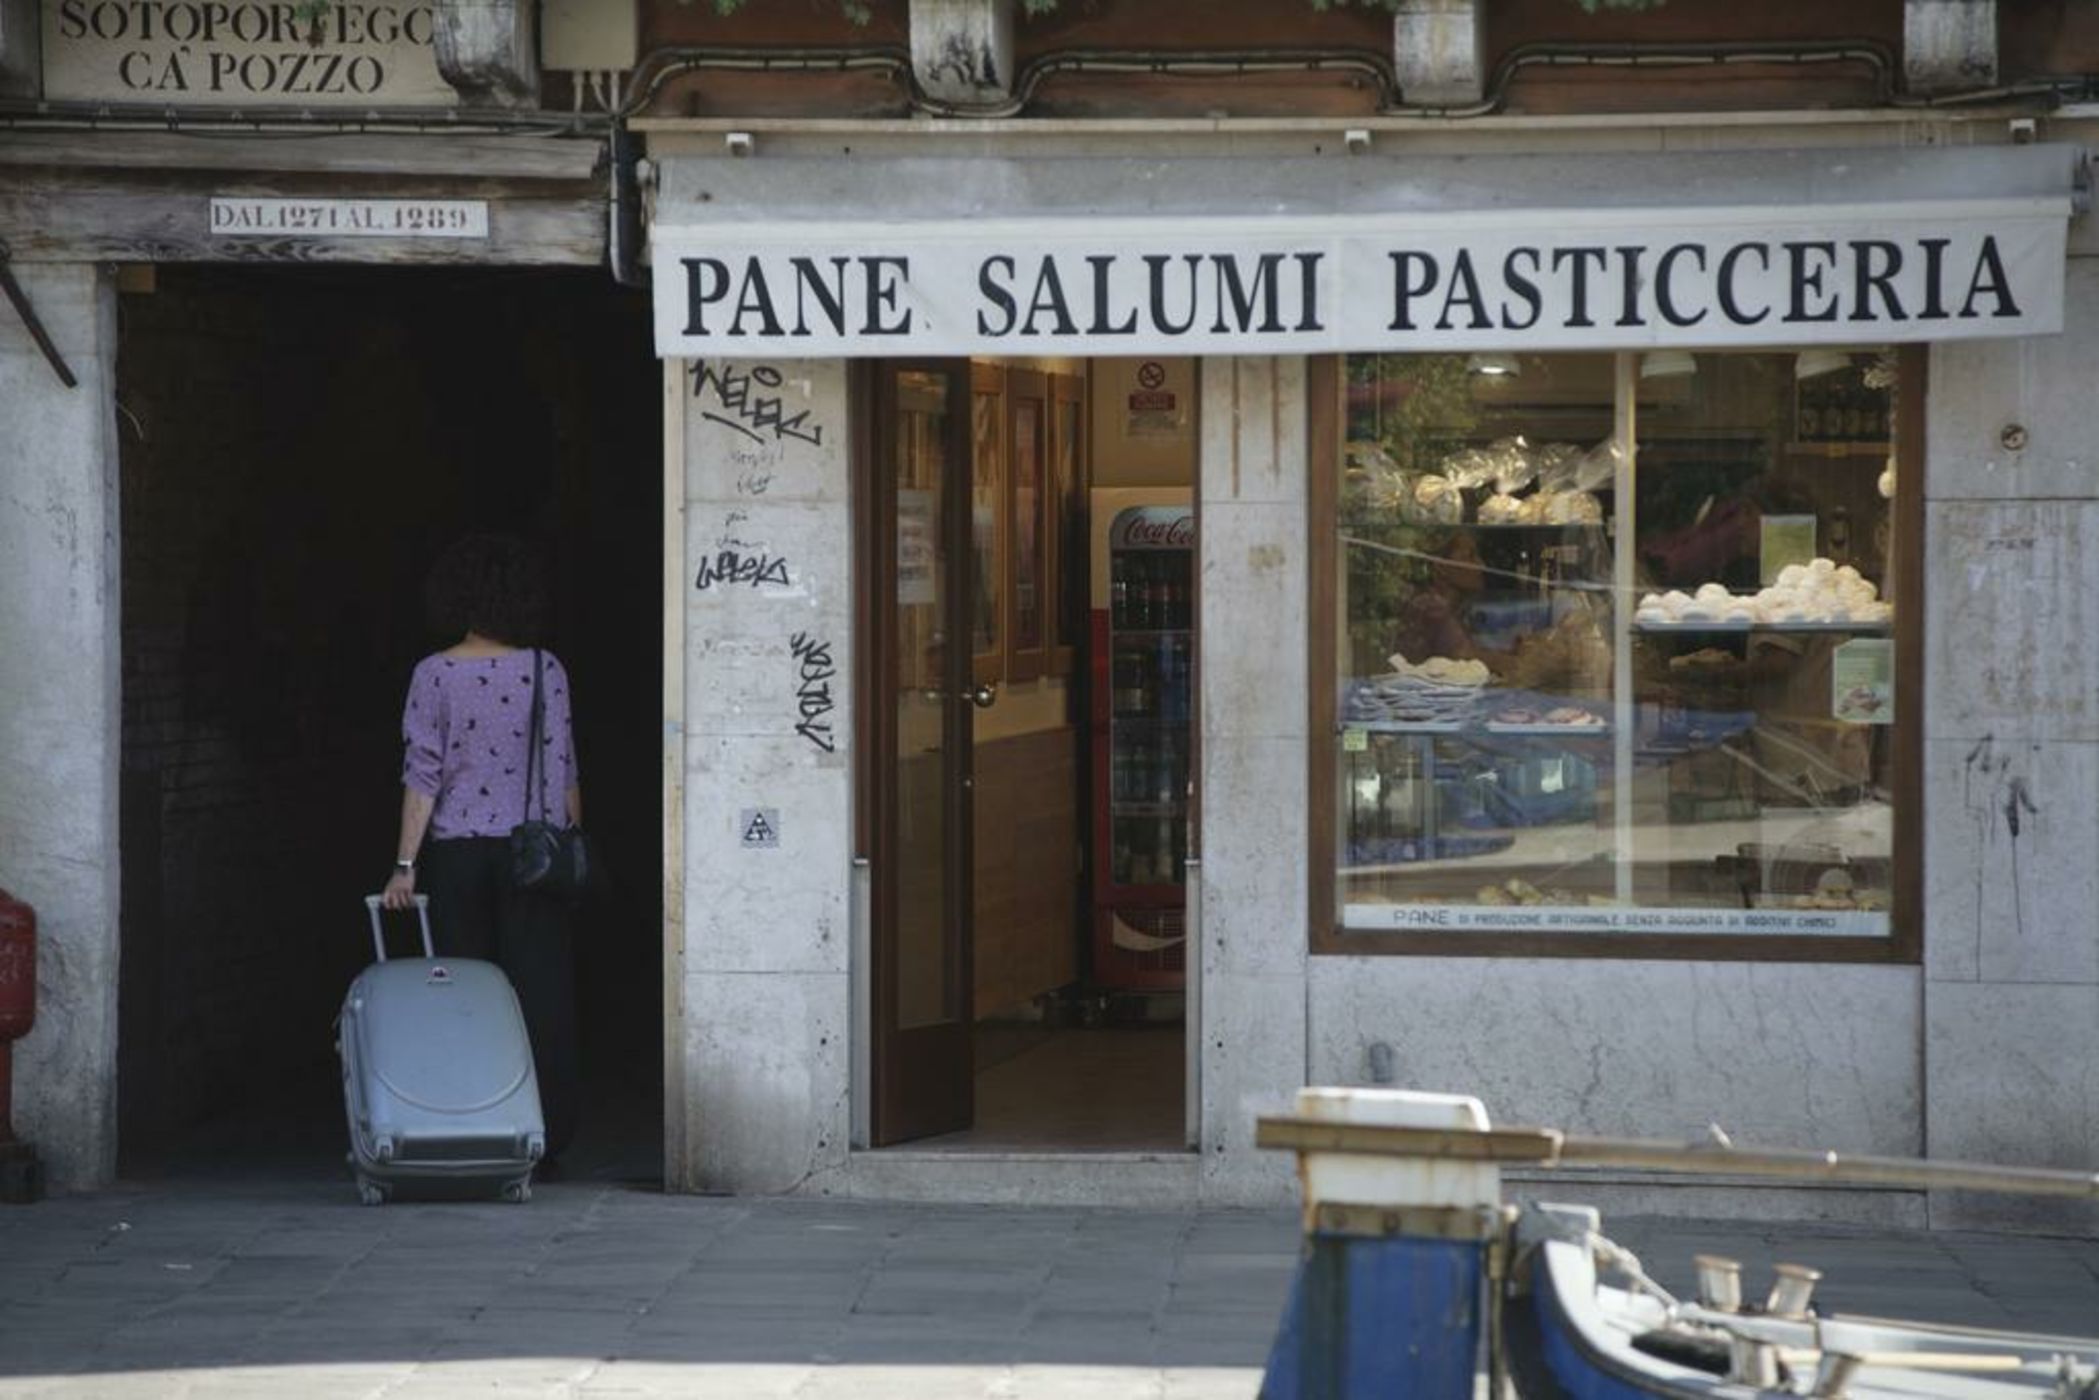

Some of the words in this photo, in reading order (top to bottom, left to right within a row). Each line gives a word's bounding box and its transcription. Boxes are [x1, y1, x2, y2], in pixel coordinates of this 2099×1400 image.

[209, 52, 384, 94] POZZO
[214, 204, 273, 228] DAL
[279, 206, 338, 228] 1271
[395, 207, 467, 230] 1289
[680, 256, 912, 336] PANE
[976, 252, 1325, 337] SALUMI
[1387, 235, 2022, 331] PASTICCERIA
[1393, 909, 1451, 925] PANE
